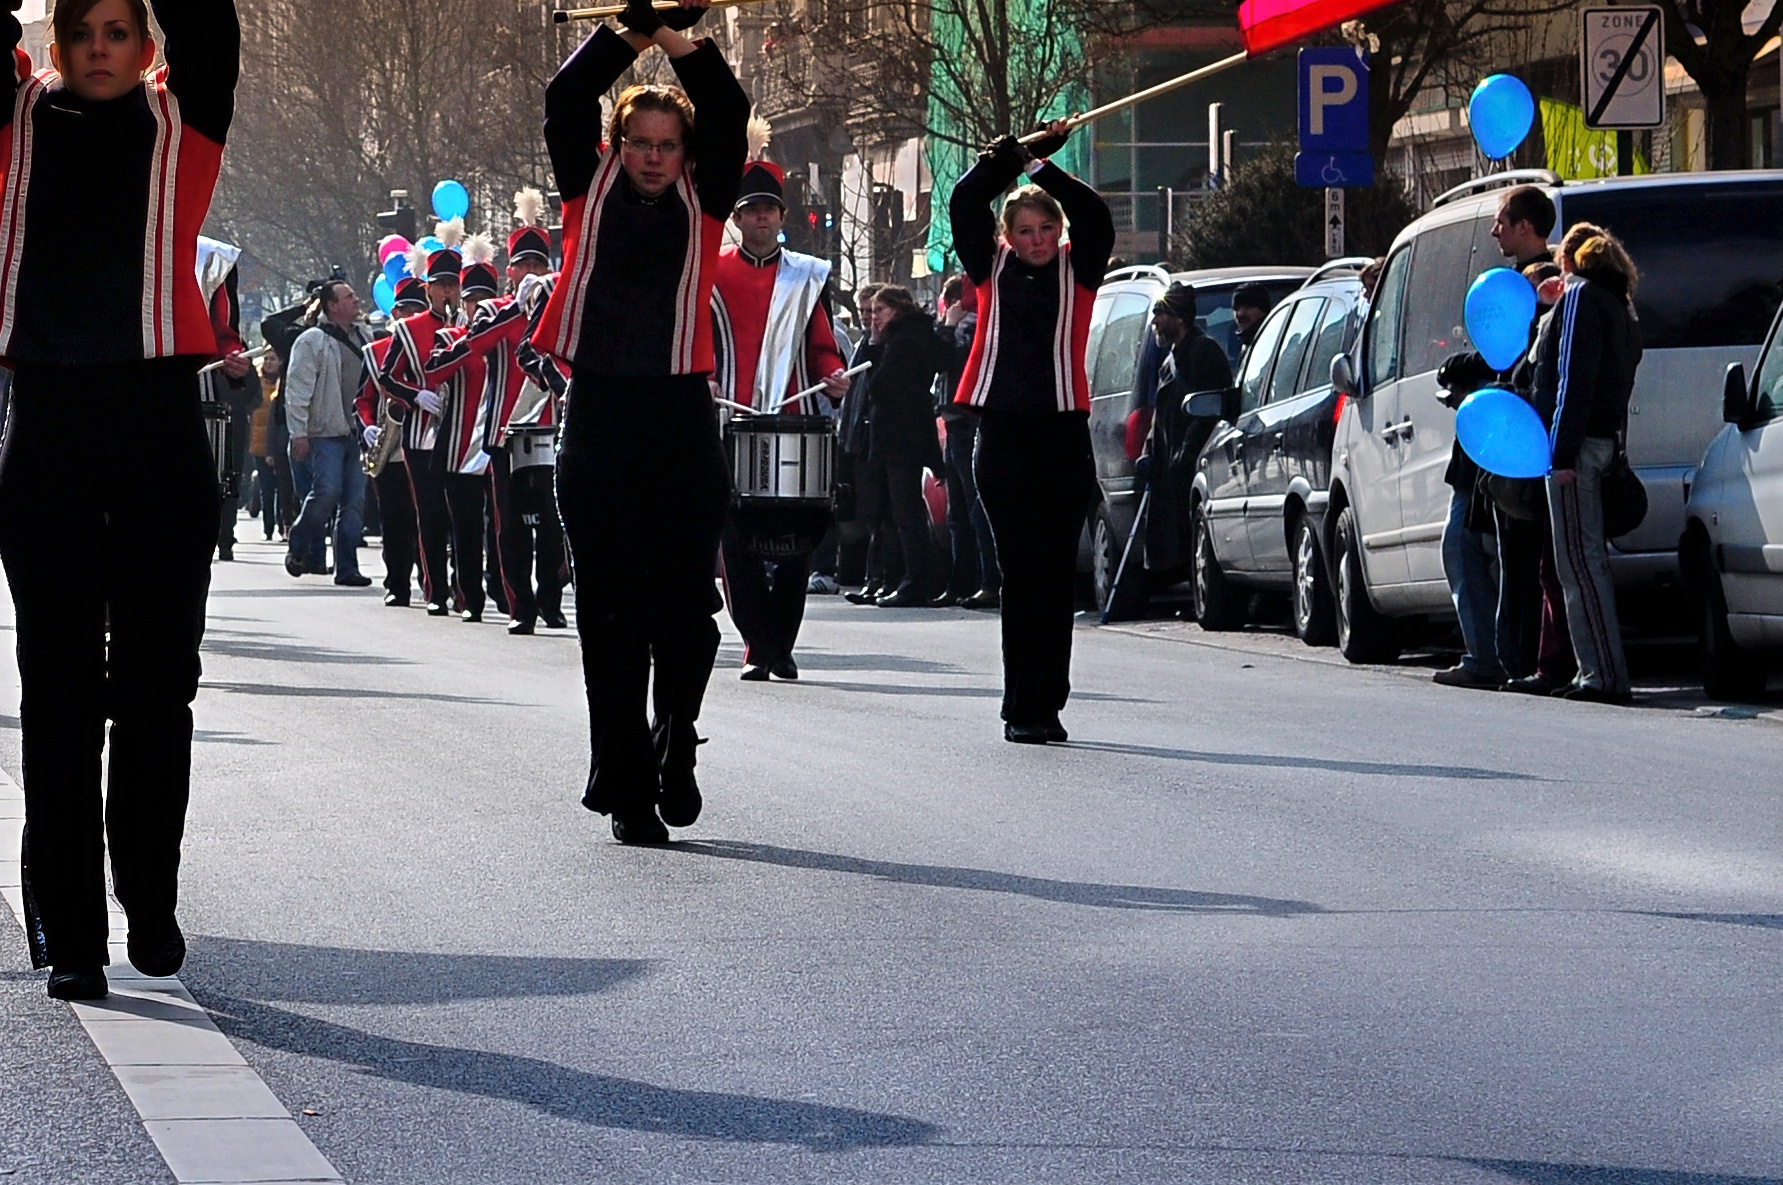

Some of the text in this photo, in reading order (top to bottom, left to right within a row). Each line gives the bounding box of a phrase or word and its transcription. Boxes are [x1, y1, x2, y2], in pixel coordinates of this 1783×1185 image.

[1601, 16, 1642, 28] ZONE
[1599, 49, 1649, 82] 30
[1309, 65, 1358, 135] P
[1331, 191, 1339, 202] 6
